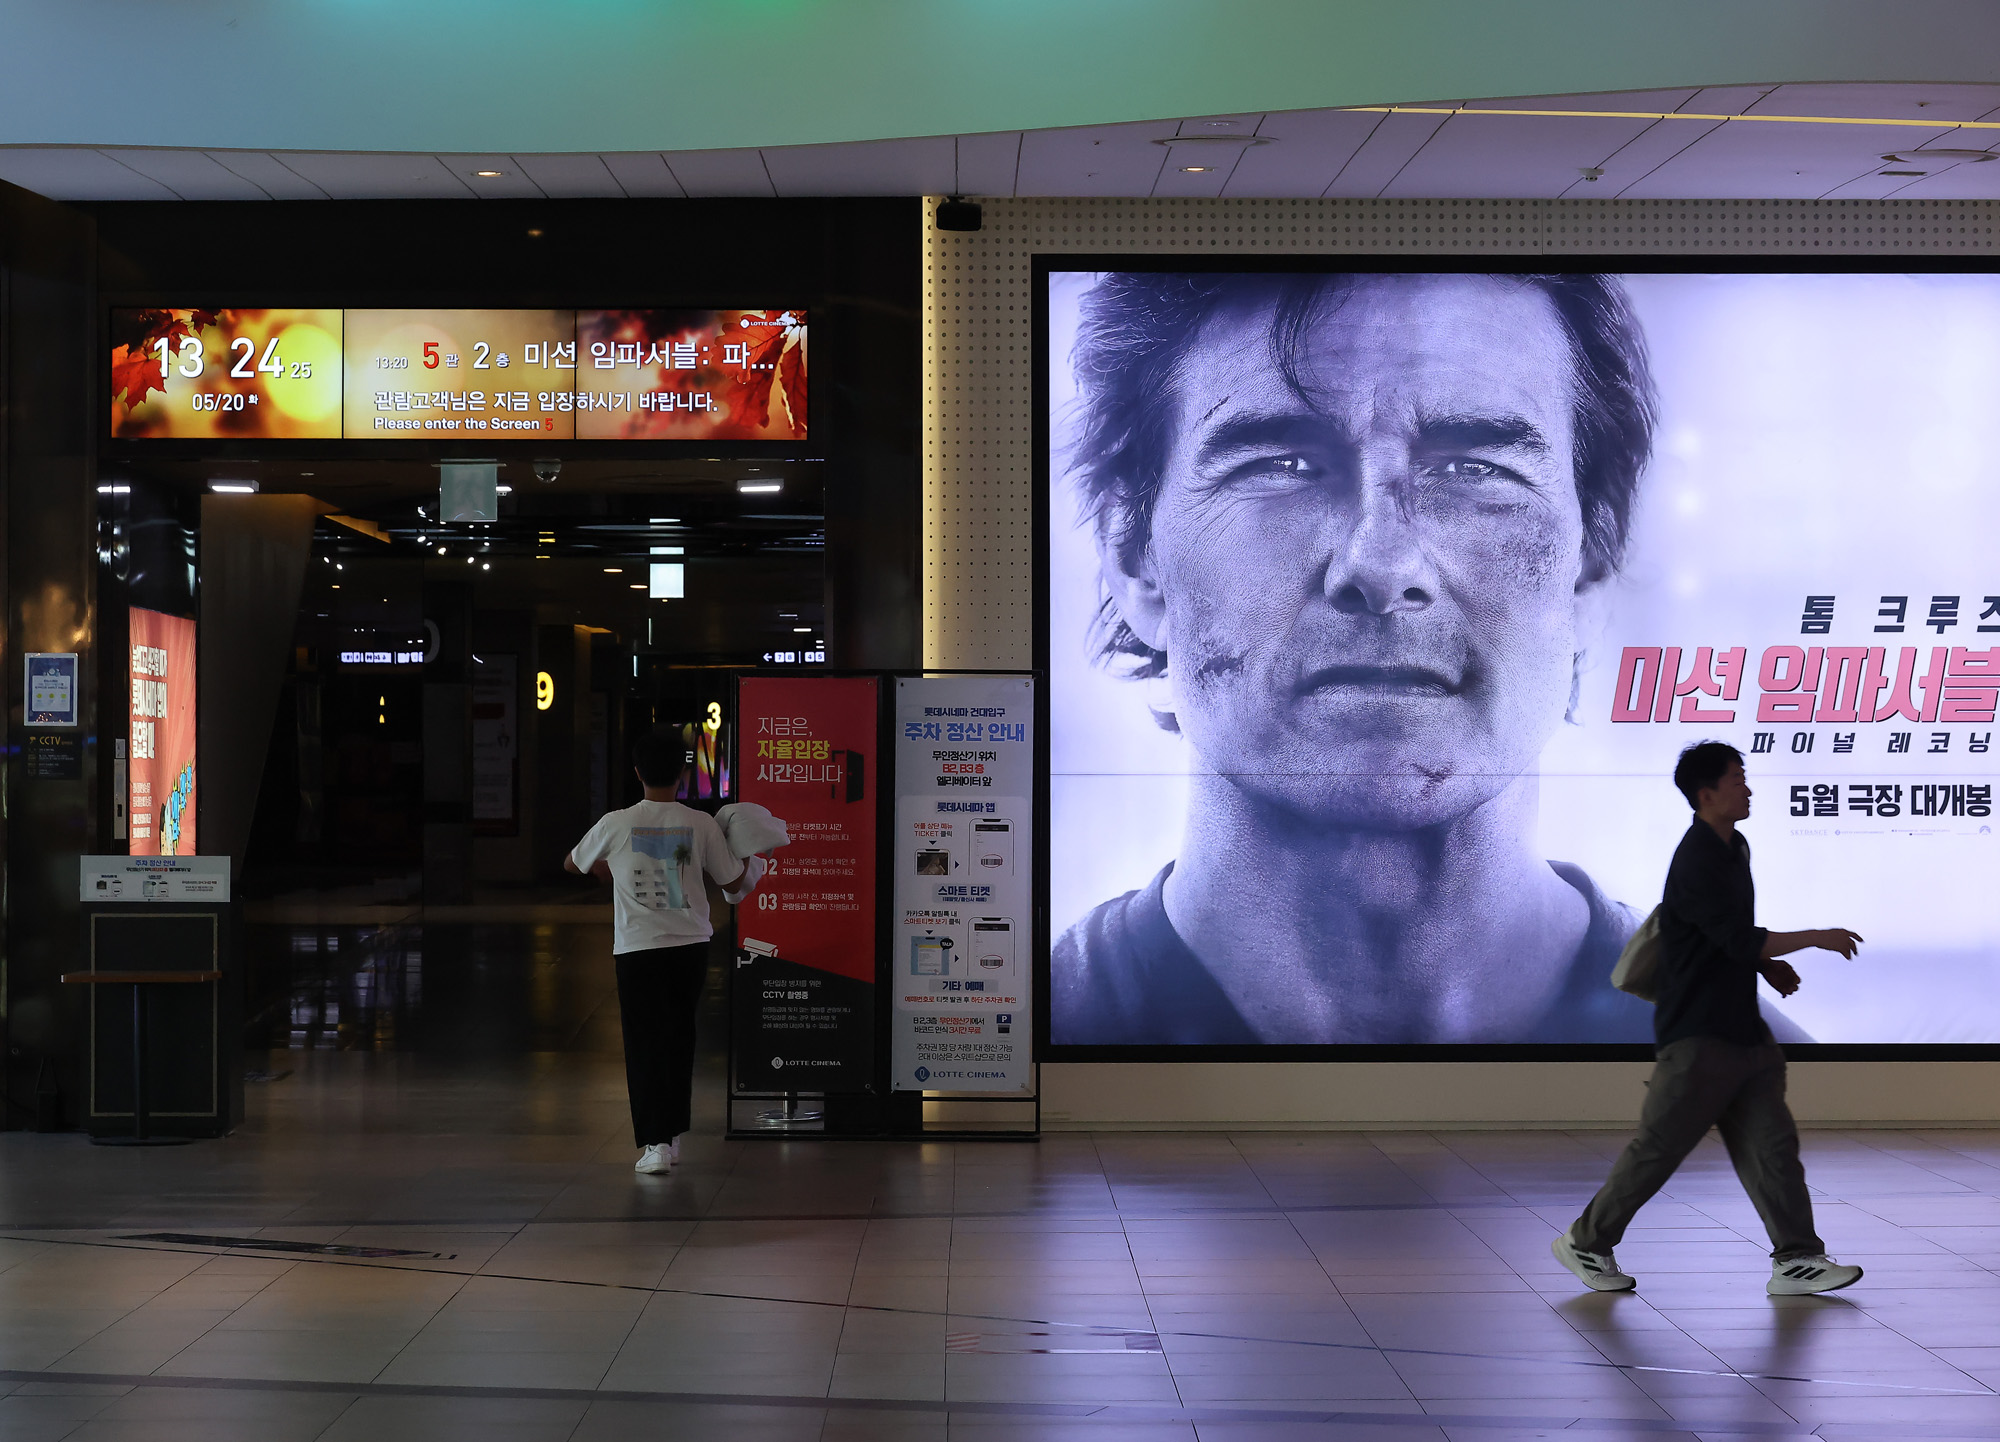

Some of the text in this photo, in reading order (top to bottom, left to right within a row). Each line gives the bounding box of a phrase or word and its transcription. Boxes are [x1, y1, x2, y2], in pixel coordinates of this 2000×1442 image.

[152, 337, 312, 379] 13 24 25
[375, 340, 775, 371] 13:20 5 관 2 층 미션 임파서블: 파...
[192, 392, 259, 412] 05/20 화
[374, 391, 718, 413] 관람고객님은 지금 입장하시기 바랍니다.
[374, 417, 554, 432] Please enter the Screen 5
[1801, 595, 1836, 634] 톰
[1611, 645, 2000, 723] 미션 임파서블
[536, 670, 555, 711] 9
[706, 702, 721, 730] 3
[924, 707, 1006, 717] 롯데시네마 건대입구
[757, 717, 814, 737] 지금은,
[904, 722, 1025, 742] 주차 정산 안내
[39, 736, 61, 745] CCTV
[1750, 732, 1991, 754] 파이널 레코닝
[756, 740, 830, 760] 자율입장
[932, 751, 996, 762] 무인정산기 위치
[756, 763, 843, 783] 시간입니다
[936, 776, 992, 787] 엘리베이터 앞
[1790, 783, 1992, 818] 5월 극장 대개봉
[937, 802, 996, 812] 롯데시네마 앱
[802, 823, 828, 831] 티켓표기
[829, 823, 842, 831] 시간
[914, 822, 953, 830] 어플 상단 메뉴
[799, 833, 817, 841] 전부터
[914, 830, 953, 838] TICKET 클릭
[782, 868, 801, 876] 지정된
[802, 868, 821, 876] 좌석에
[938, 885, 990, 896] 스마트 티켓
[758, 893, 778, 910] 03
[796, 893, 809, 901] 시작
[782, 903, 807, 911] 관람등급
[808, 903, 828, 911] 확인이
[906, 910, 958, 918] 카카오톡 알림톡 내
[942, 980, 984, 992] 기타 예매
[762, 991, 809, 1000] CCTV 촬영중
[940, 1016, 985, 1026] 무인정산기에서
[914, 1026, 981, 1034] 바코드 인식 3시간 무료
[916, 1043, 938, 1052] 주차권
[949, 1043, 957, 1052] 당
[957, 1043, 972, 1052] 차량
[984, 1043, 998, 1052] 정산
[999, 1043, 1013, 1052] 가능
[918, 1052, 931, 1062] 2대
[932, 1052, 953, 1062] 이상은
[996, 1052, 1011, 1062] 문의
